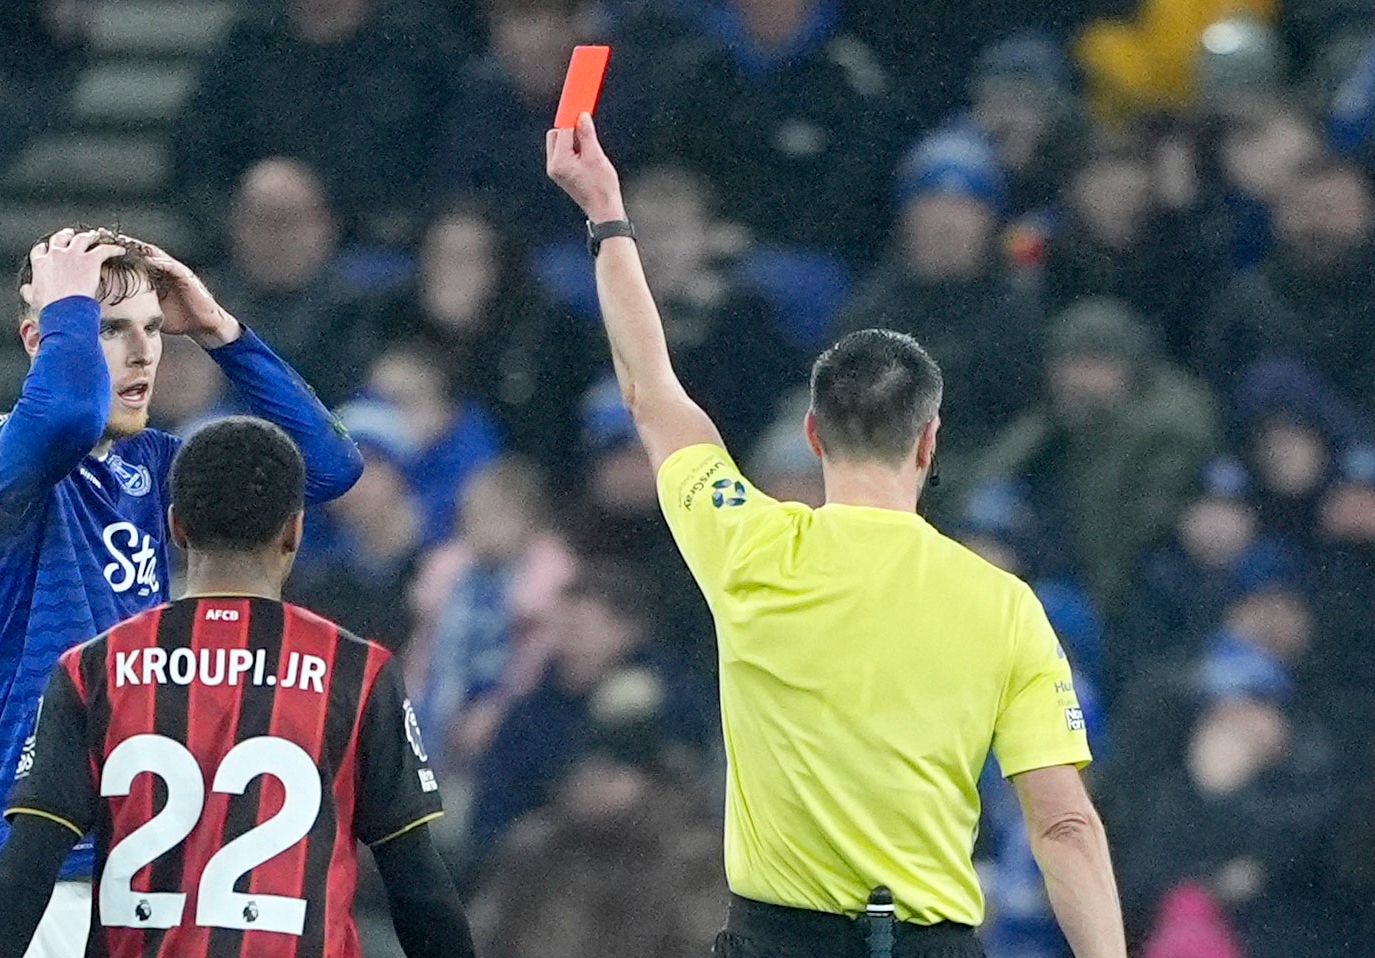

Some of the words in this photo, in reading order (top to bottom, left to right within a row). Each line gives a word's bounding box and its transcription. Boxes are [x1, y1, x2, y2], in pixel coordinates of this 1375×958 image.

[205, 608, 240, 622] AFCB
[115, 646, 327, 694] KROUPI.JR
[99, 733, 323, 937] 22
